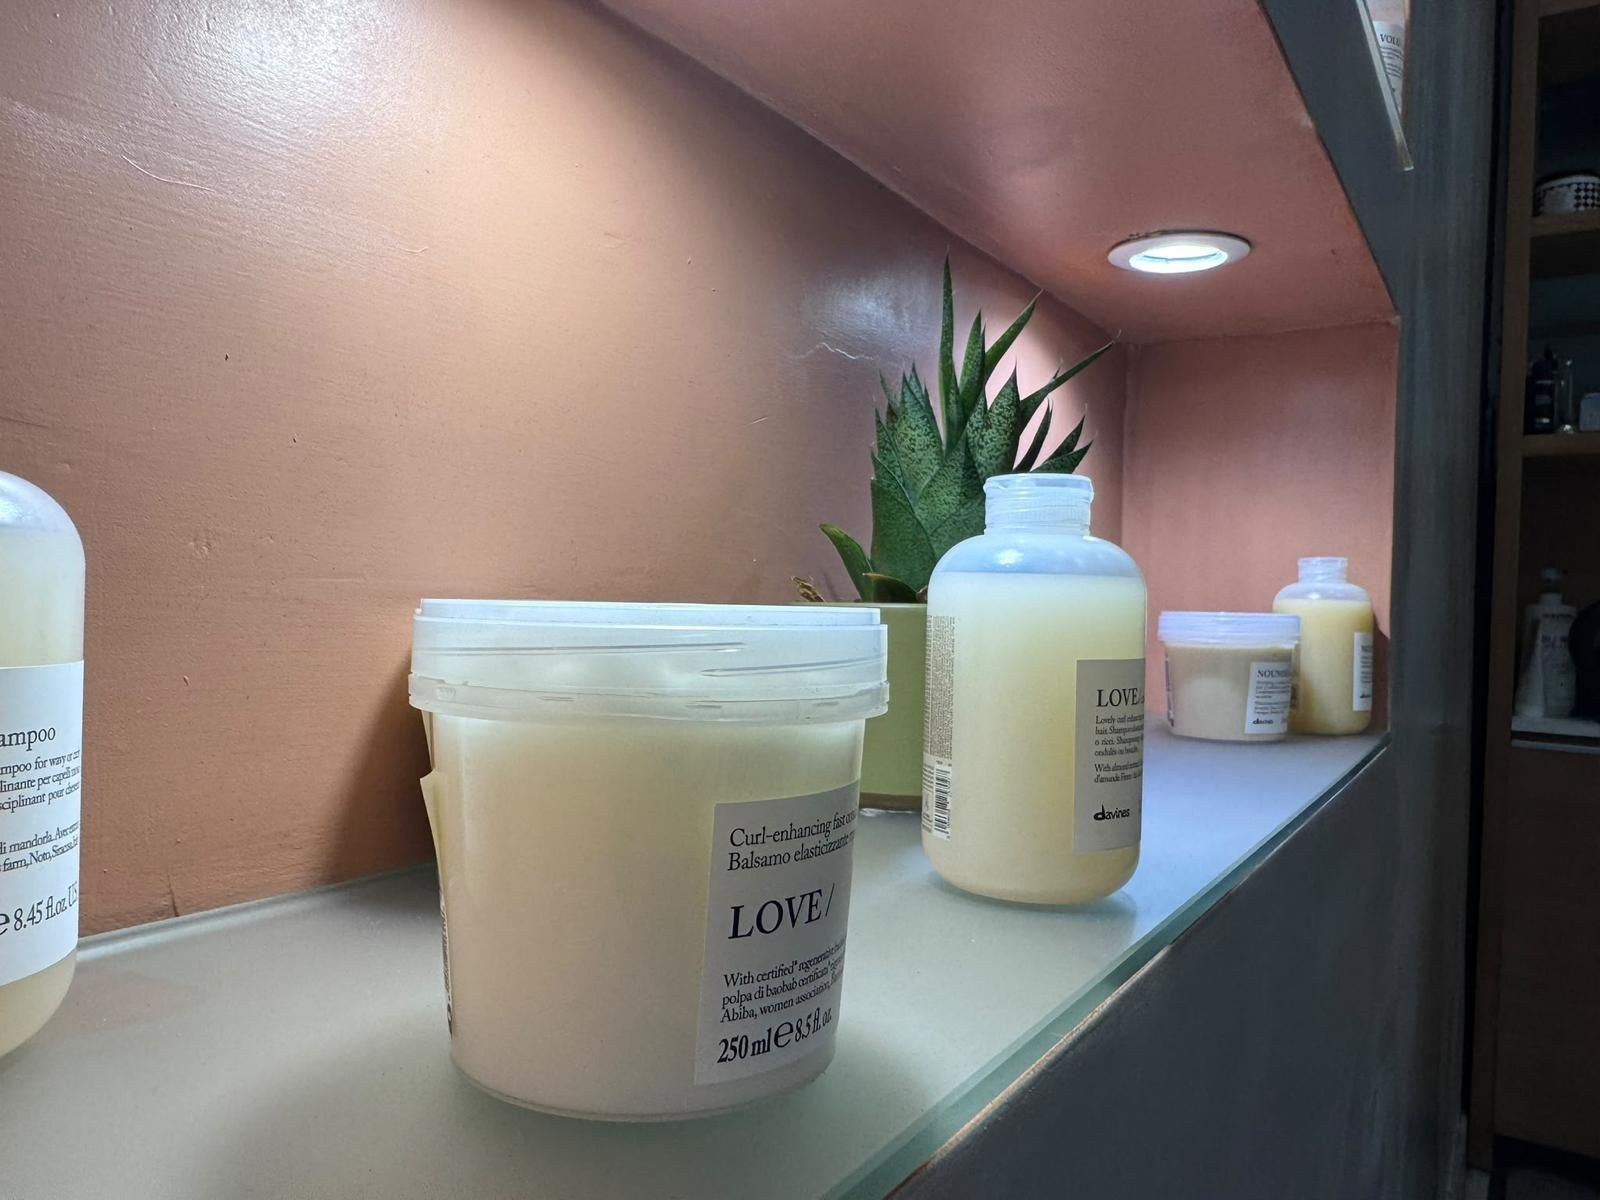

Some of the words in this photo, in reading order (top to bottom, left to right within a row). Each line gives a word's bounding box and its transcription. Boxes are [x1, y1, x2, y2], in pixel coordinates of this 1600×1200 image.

[1096, 688, 1138, 707] LOVE
[35, 756, 48, 770] for
[49, 755, 66, 768] wavy
[37, 776, 51, 791] per
[1094, 804, 1130, 821] davines
[730, 819, 832, 847] Curl-enhancing
[833, 812, 845, 830] fast
[728, 850, 791, 871] Balsamo
[794, 834, 849, 862] elasticizzante
[14, 899, 43, 931] 8.45
[728, 889, 823, 940] LOVE
[722, 990, 752, 1010] polpa
[754, 986, 764, 1001] di
[766, 977, 797, 998] baobab
[724, 971, 754, 988] With
[720, 1006, 757, 1023] Abiba,
[760, 999, 794, 1016] women
[717, 1035, 748, 1063] 250
[751, 1027, 772, 1056] ml
[795, 1011, 813, 1043] 8.5
